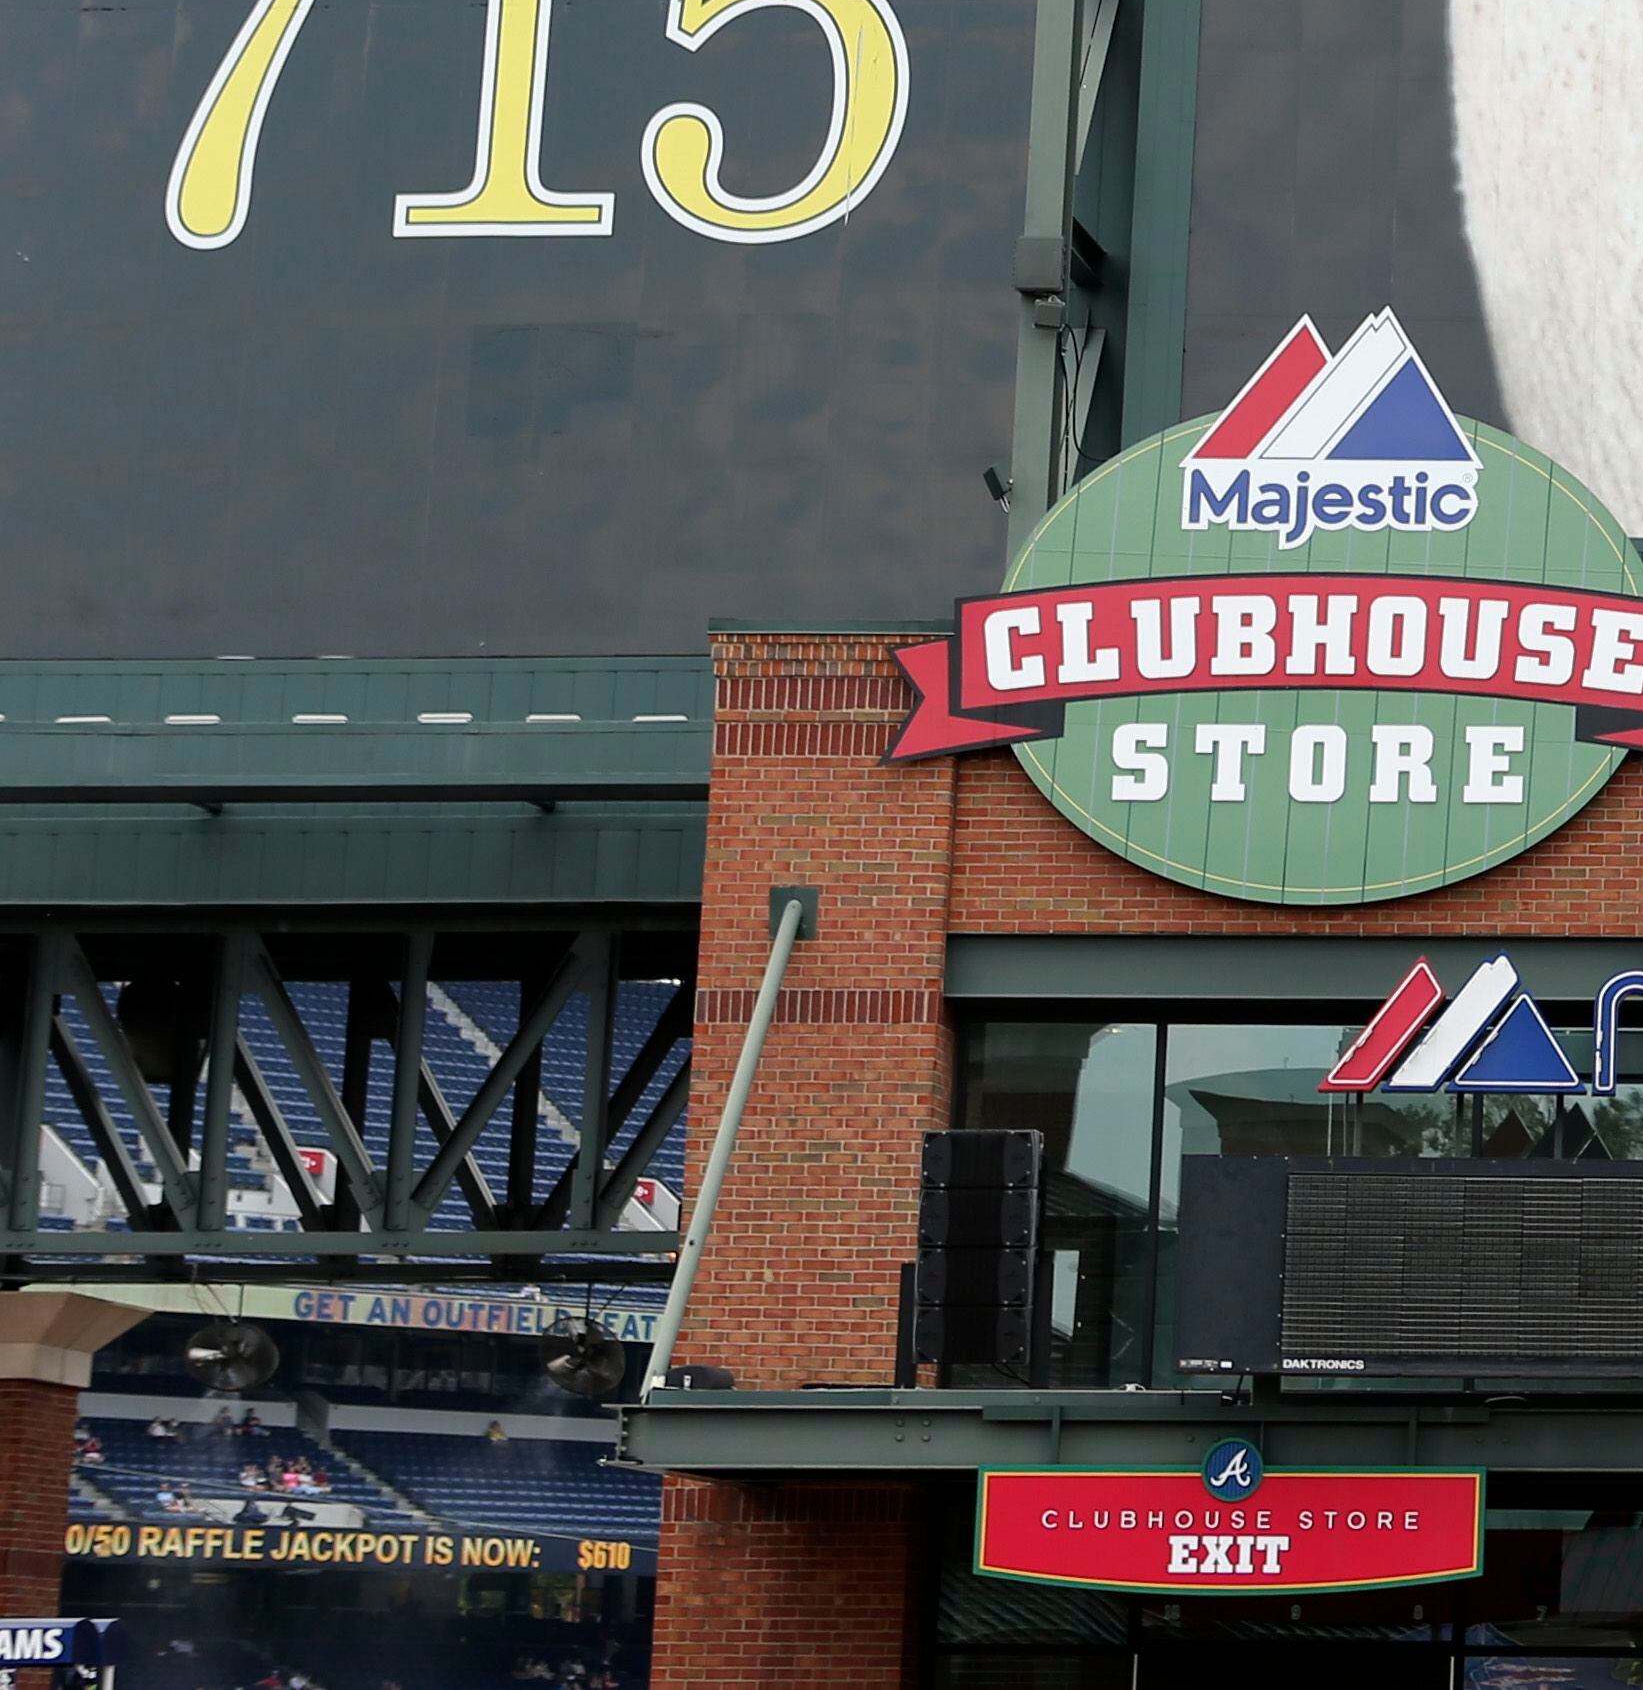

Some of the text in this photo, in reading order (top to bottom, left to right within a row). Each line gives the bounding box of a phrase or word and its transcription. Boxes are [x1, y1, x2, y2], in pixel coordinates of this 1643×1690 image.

[1188, 466, 1473, 544] Majestic
[1110, 722, 1526, 805] STORE
[294, 1290, 356, 1321] GET
[367, 1297, 411, 1326] AN
[1282, 1358, 1365, 1371] DAKTRONICS
[1210, 1447, 1252, 1487] A
[1040, 1510, 1420, 1530] CLUBHOUSE STORE
[137, 1526, 263, 1560] RAFFLE
[270, 1529, 418, 1564] JACKPOT
[424, 1536, 454, 1565] IS
[460, 1538, 541, 1568] NOW:
[577, 1539, 631, 1570] $610
[1166, 1535, 1290, 1575] EXIT
